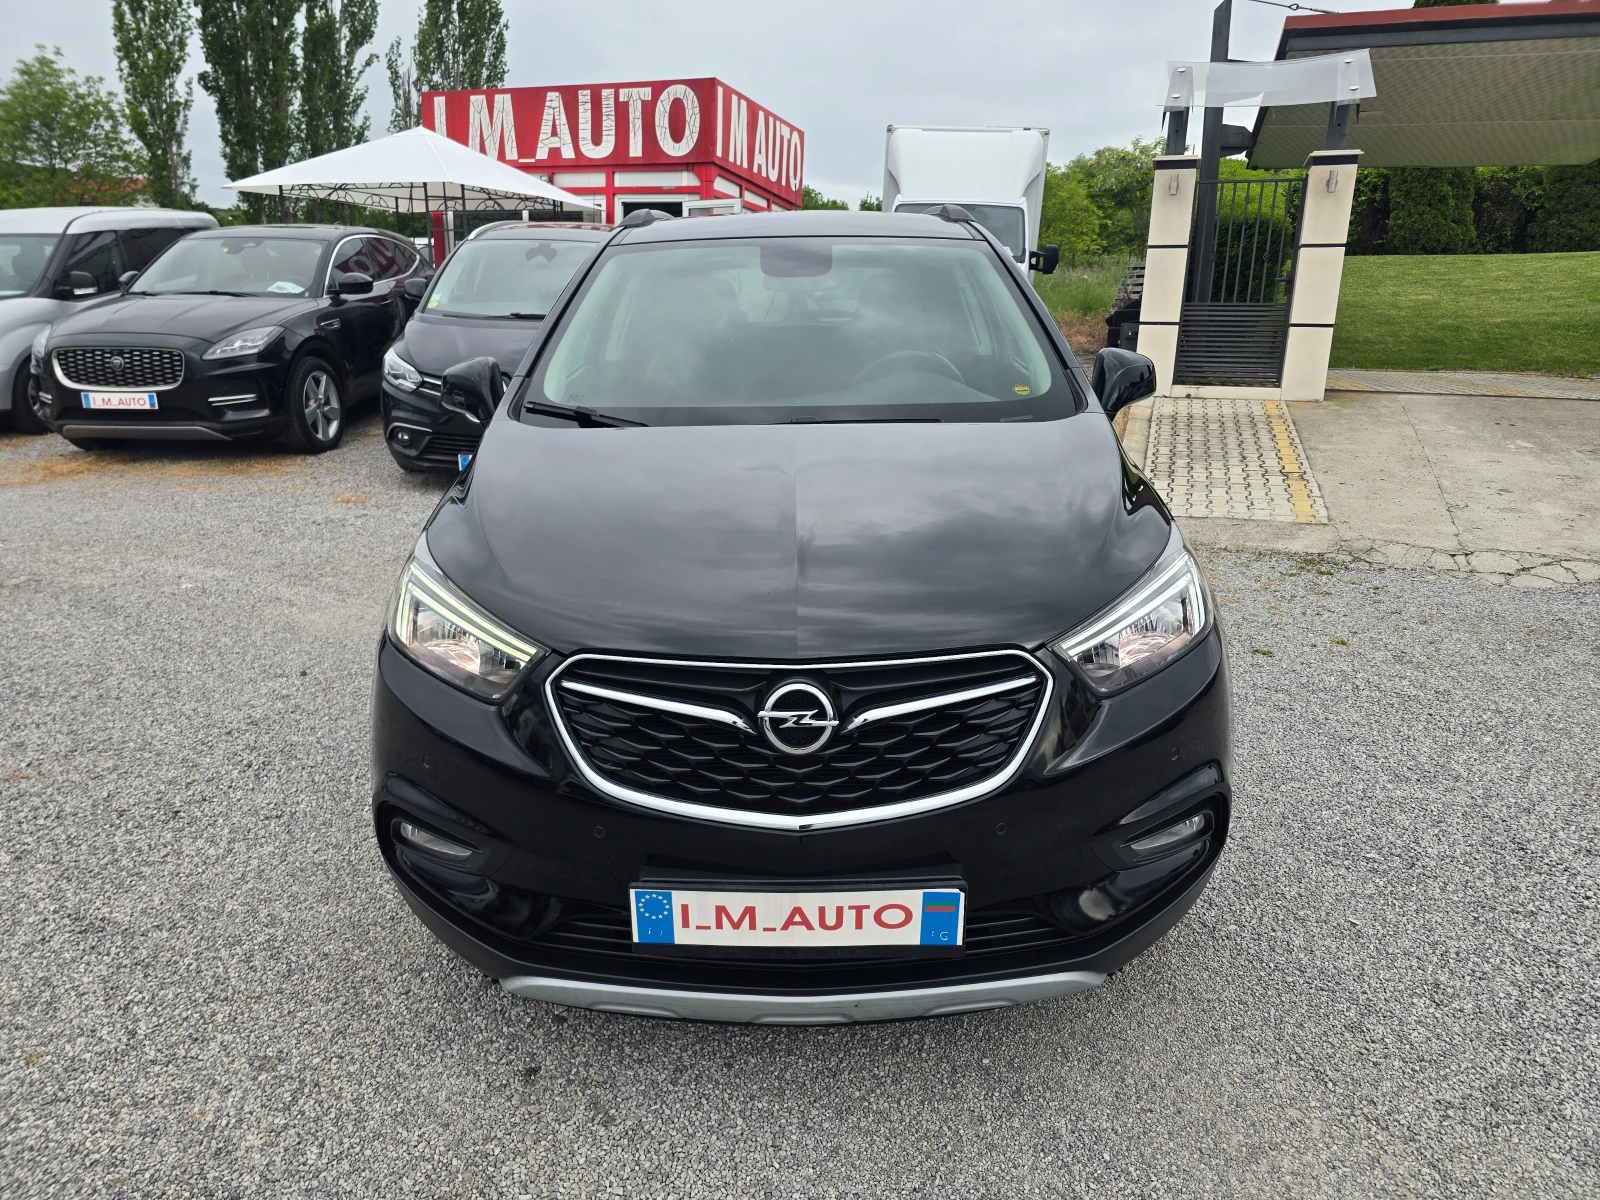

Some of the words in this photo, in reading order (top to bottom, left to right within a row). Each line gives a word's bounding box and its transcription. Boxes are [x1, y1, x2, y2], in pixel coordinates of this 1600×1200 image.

[716, 85, 723, 157] I
[729, 94, 748, 169] M
[753, 110, 801, 192] AUTO
[680, 903, 914, 932] I_M_AUTO
